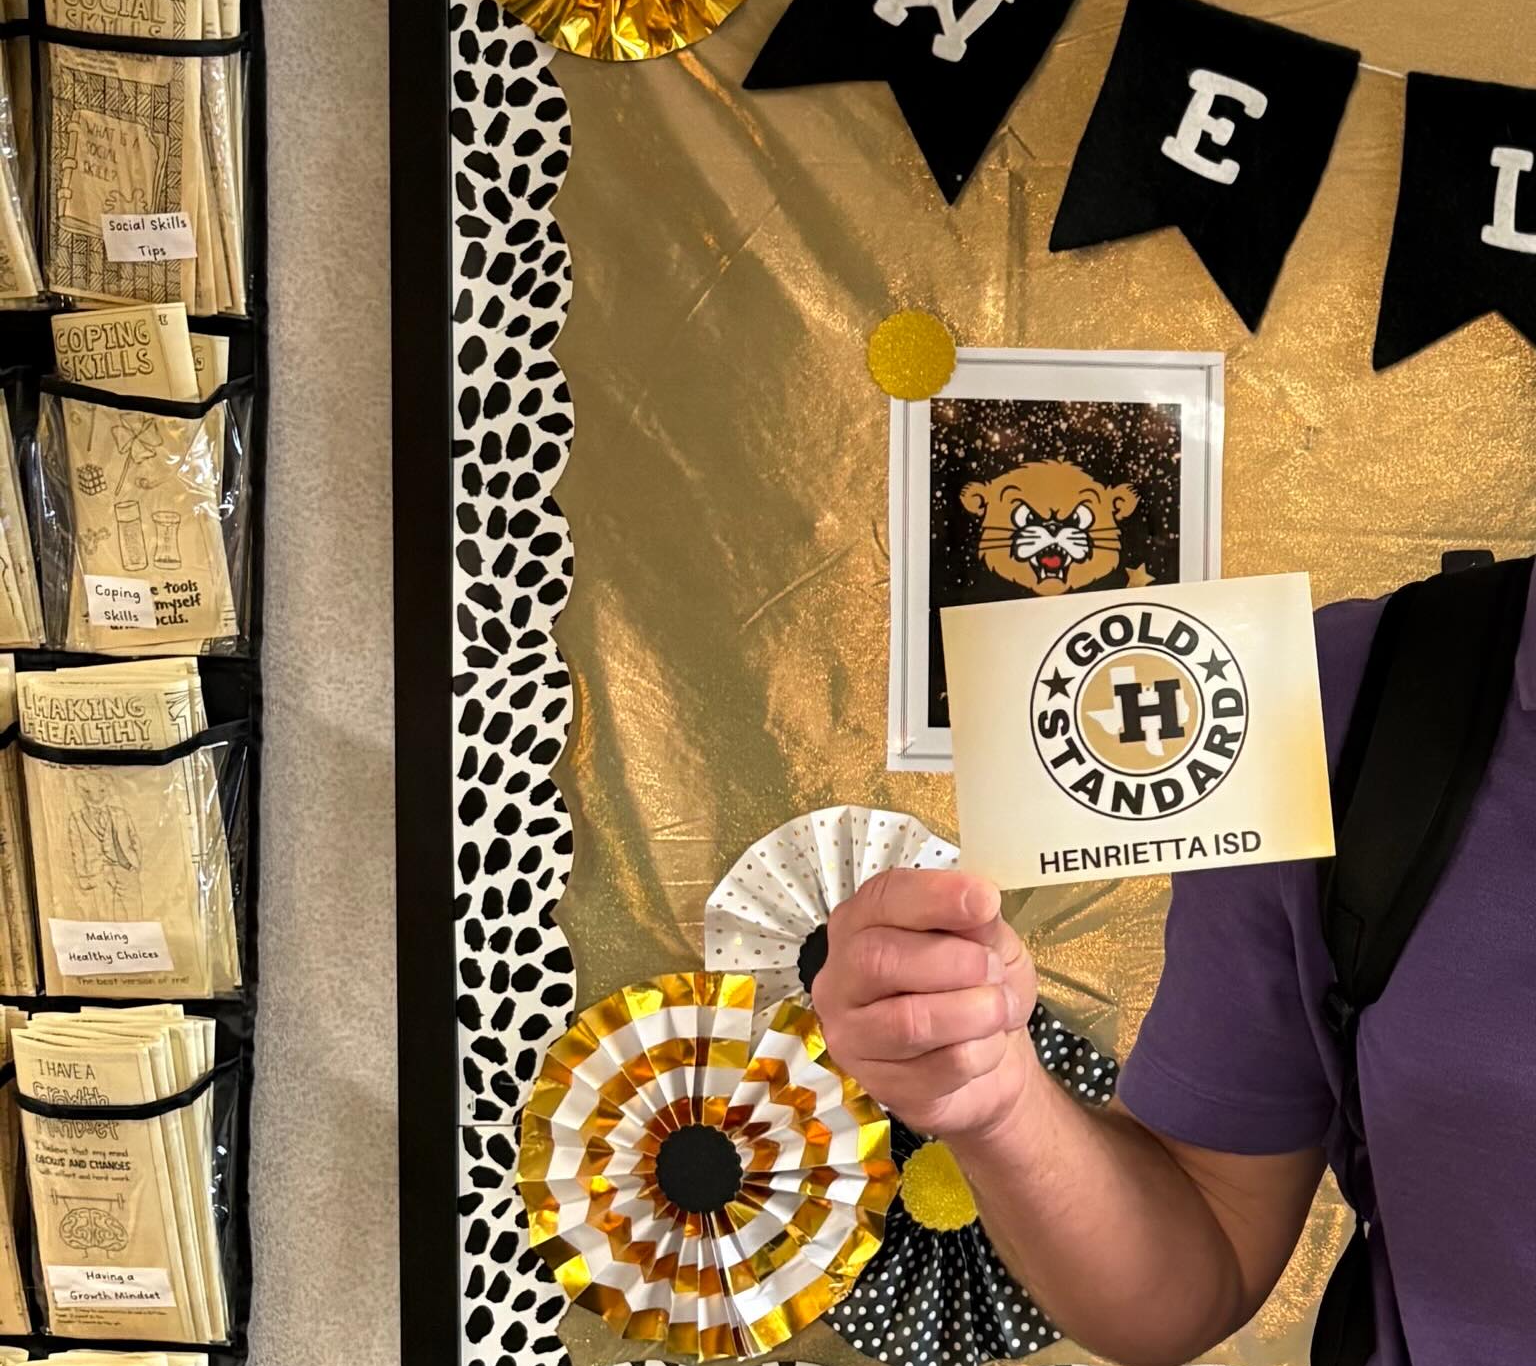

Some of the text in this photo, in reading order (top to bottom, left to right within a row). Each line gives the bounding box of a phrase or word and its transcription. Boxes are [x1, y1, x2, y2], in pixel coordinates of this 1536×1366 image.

[109, 216, 188, 231] Social Skills
[138, 245, 167, 260] Tips
[55, 319, 151, 354] COPING
[60, 348, 154, 382] SKILLS
[95, 584, 141, 604] Coping
[1066, 611, 1201, 669] GOLD
[33, 694, 146, 719] MAKING
[1113, 677, 1187, 744] H
[36, 719, 153, 746] HEALTHY
[1037, 687, 1246, 816] STANDARD
[1039, 830, 1263, 875] HENRIETTA ISD
[86, 932, 129, 944] Making
[68, 951, 159, 965] Healthy Choices
[45, 1060, 83, 1080] HAVE
[85, 1063, 97, 1081] A
[85, 1271, 135, 1284] Having a
[69, 1291, 161, 1301] Growth Mindset
